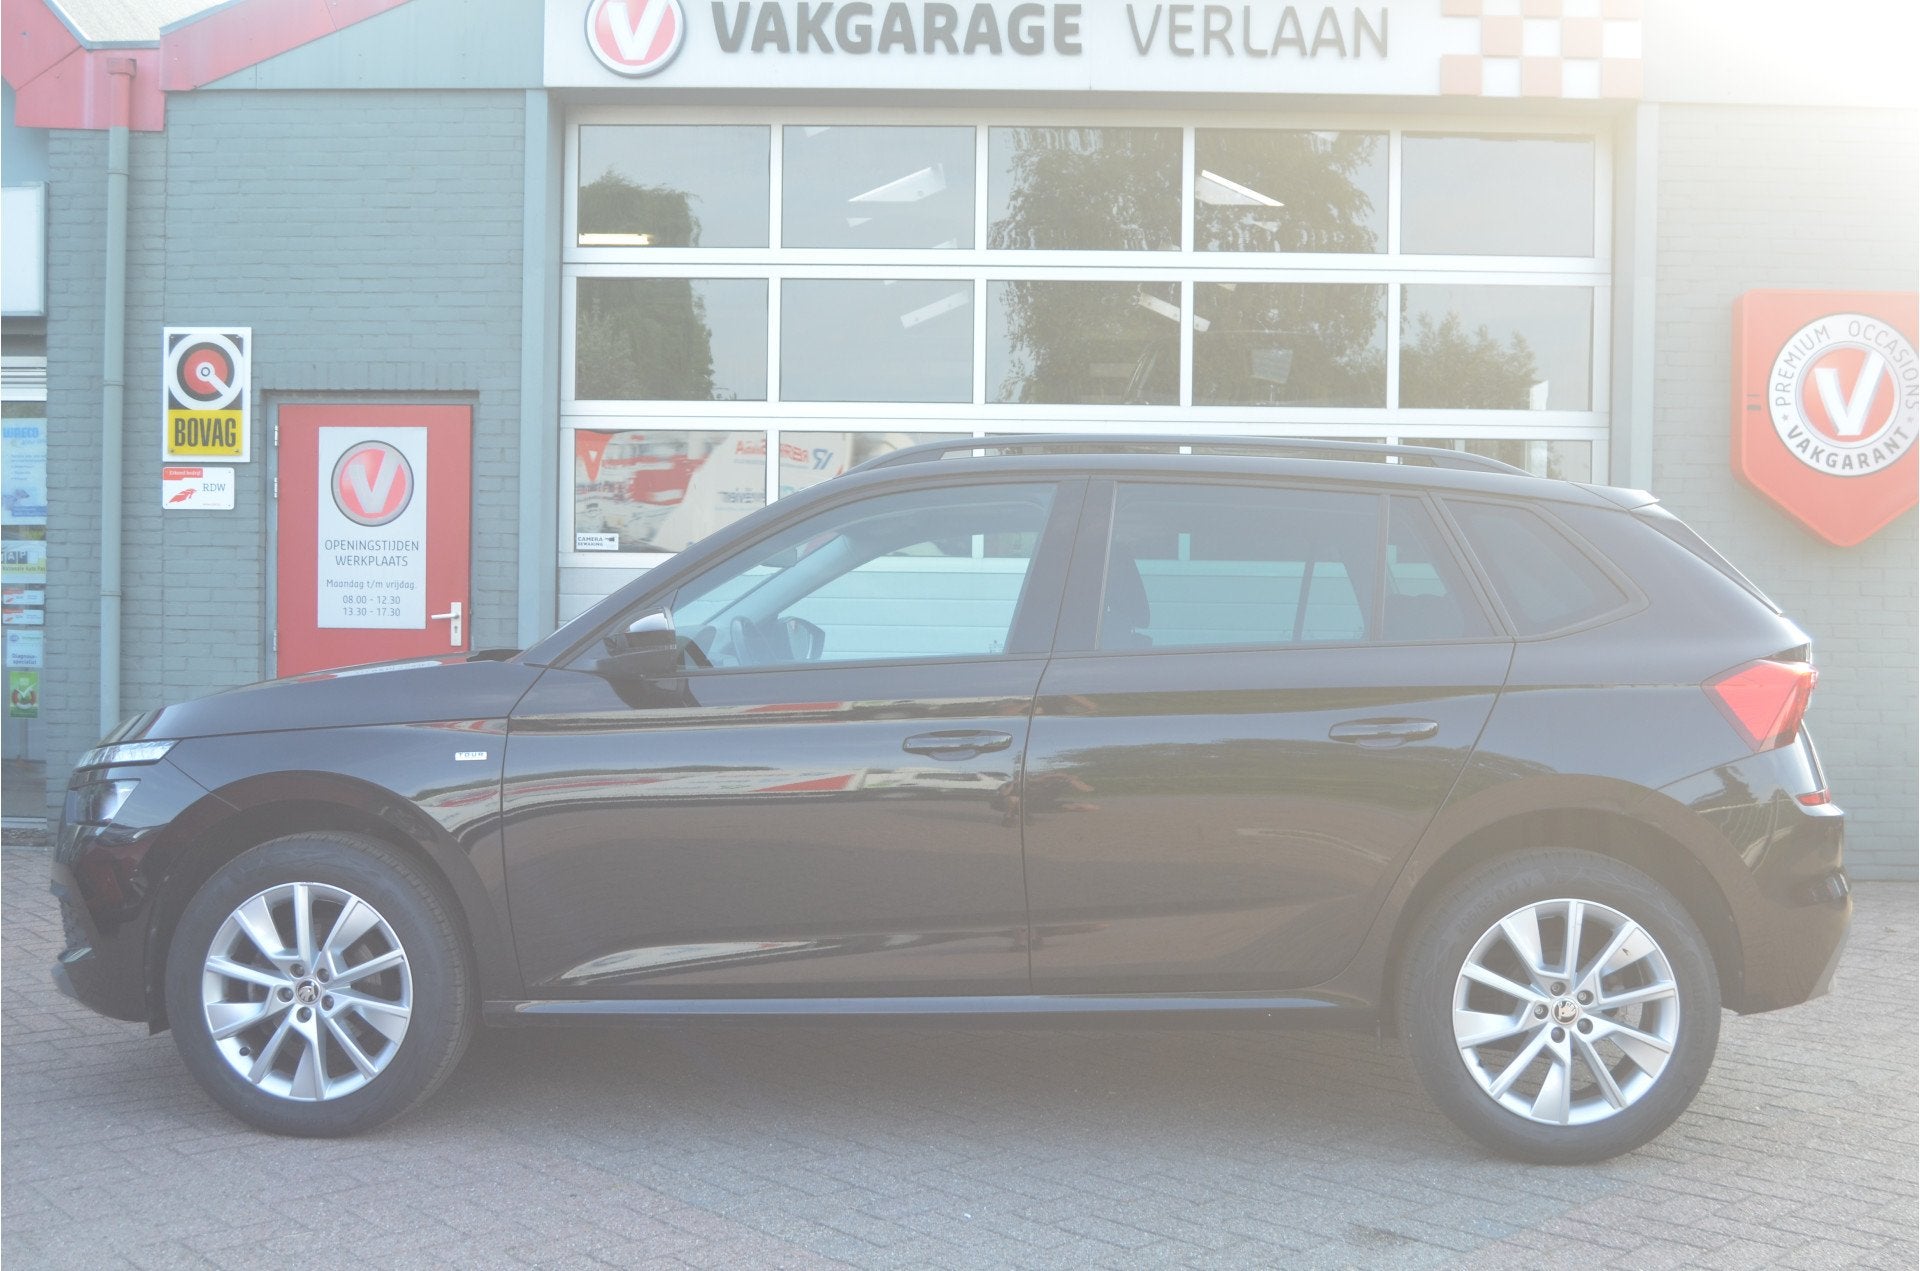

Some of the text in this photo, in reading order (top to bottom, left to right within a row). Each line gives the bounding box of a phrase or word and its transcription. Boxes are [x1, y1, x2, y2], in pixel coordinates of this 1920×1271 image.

[711, 1, 1389, 58] VAKGARAGE VERLAAN
[1775, 324, 1830, 407] PREMIUM
[1848, 320, 1919, 410] OCCASIONS
[174, 417, 237, 447] BOVAG
[1788, 425, 1909, 470] VAKGARANT
[203, 483, 226, 492] RDW
[324, 539, 419, 551] OPENINGSTIJDEN
[335, 555, 408, 567] WERKPLAATS
[326, 579, 364, 590] Maandag
[366, 580, 383, 589] t/m
[342, 595, 367, 604] 08.00
[376, 595, 401, 605] 12.30
[343, 607, 367, 616] 13.30
[376, 608, 401, 617] 17.30
